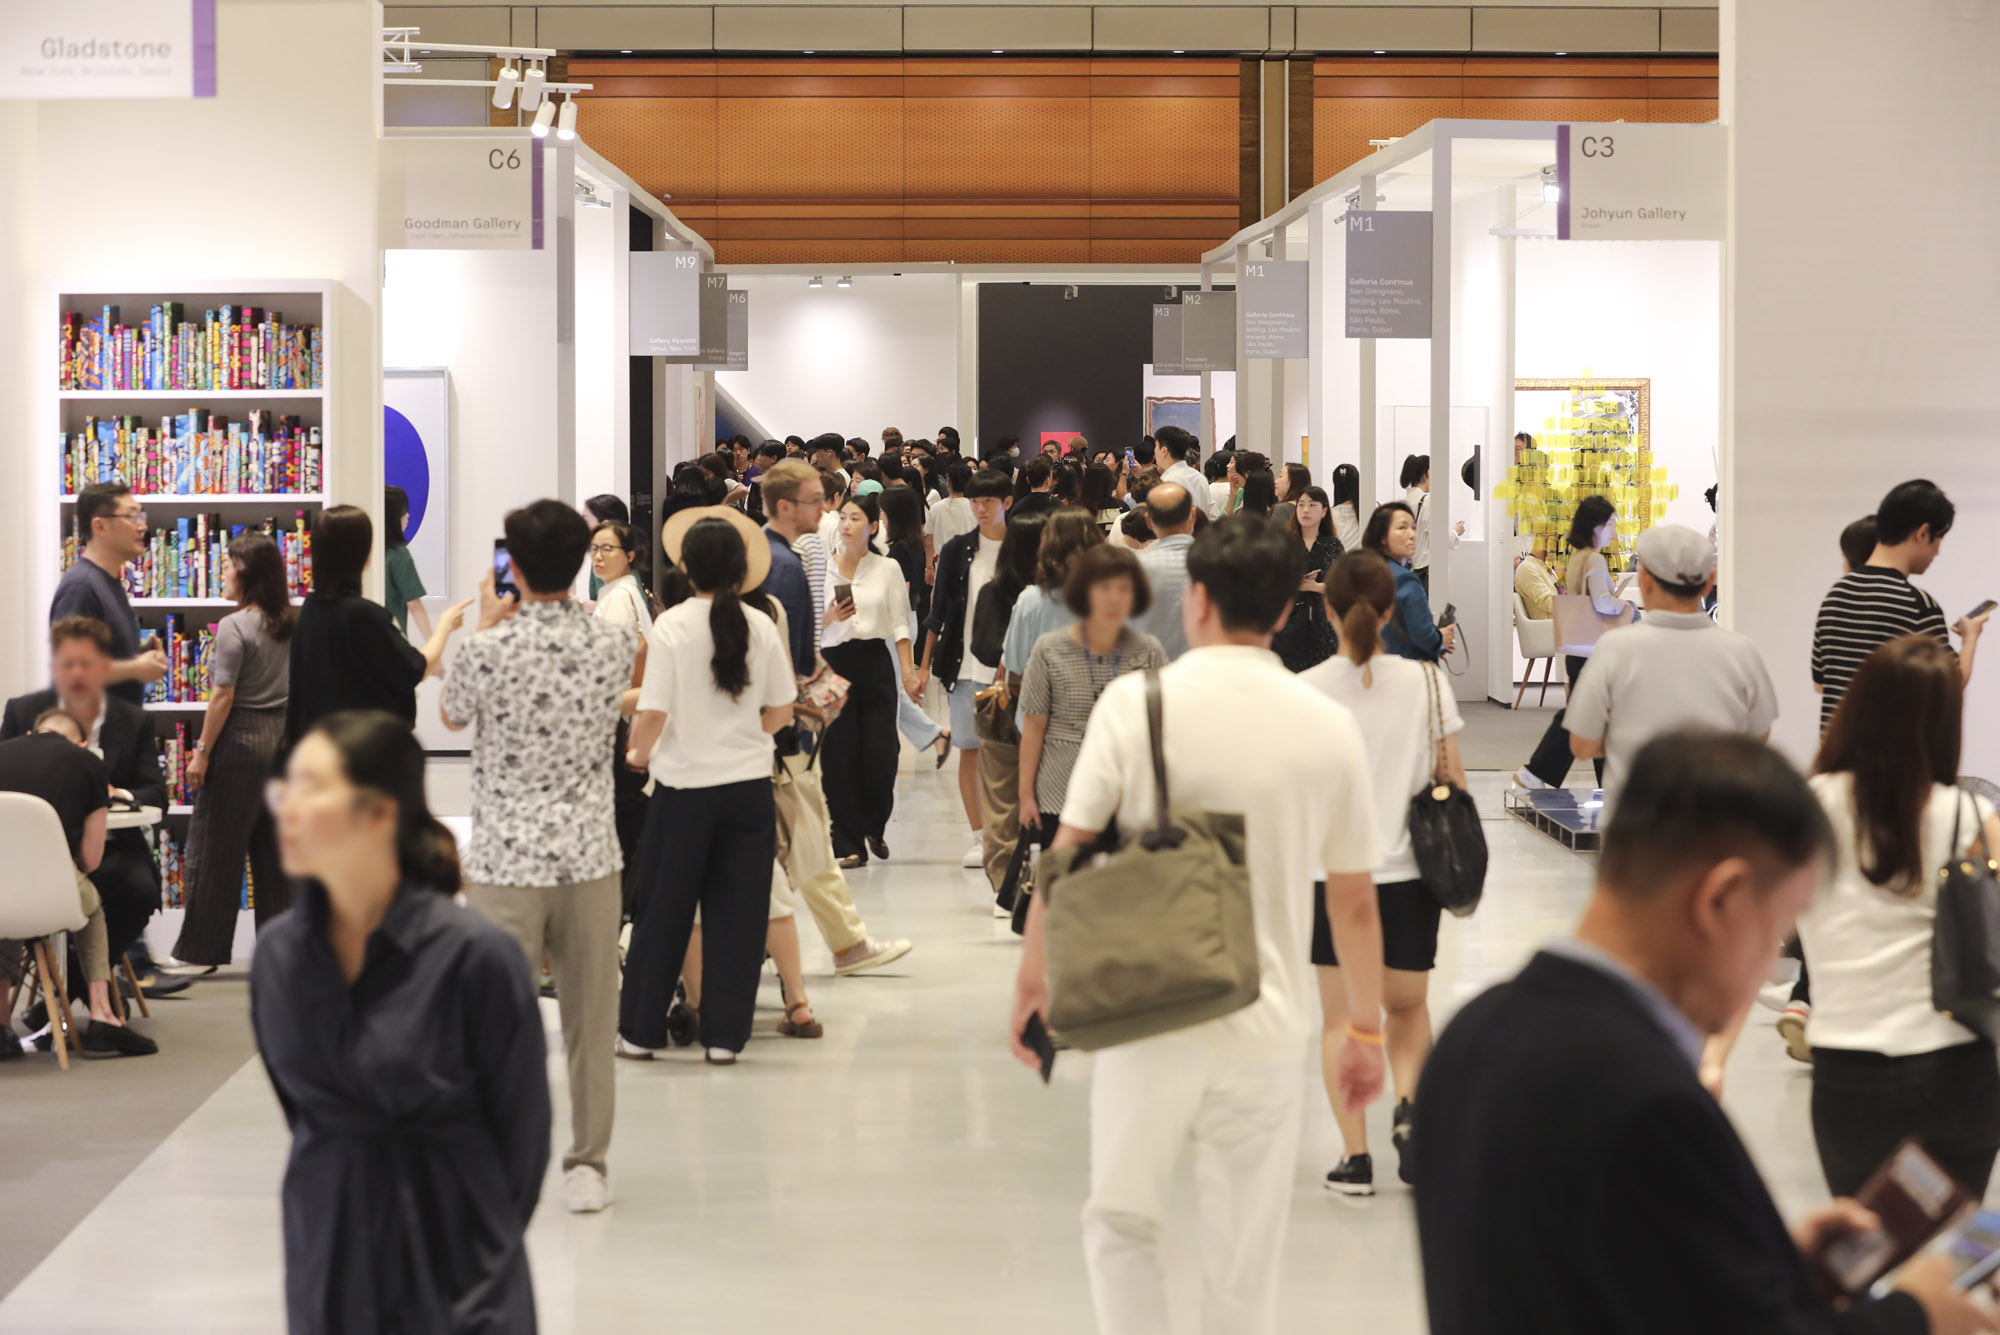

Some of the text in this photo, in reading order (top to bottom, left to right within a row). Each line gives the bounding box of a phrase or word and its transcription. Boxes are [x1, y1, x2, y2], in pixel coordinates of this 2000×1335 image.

[40, 36, 171, 59] Gladstone
[1582, 136, 1614, 157] C3
[489, 149, 521, 169] C6
[1581, 207, 1687, 222] Johyun Gallery
[404, 217, 521, 231] Goodman Gallery
[1350, 217, 1375, 231] M1
[675, 256, 696, 268] M9
[1246, 265, 1264, 277] M1
[707, 277, 725, 288] M7
[1350, 278, 1413, 286] Galleria Continua
[729, 293, 745, 303] M6
[1185, 295, 1201, 304] M2
[1154, 308, 1169, 317] M3
[649, 337, 696, 345] Gallery Hyundai
